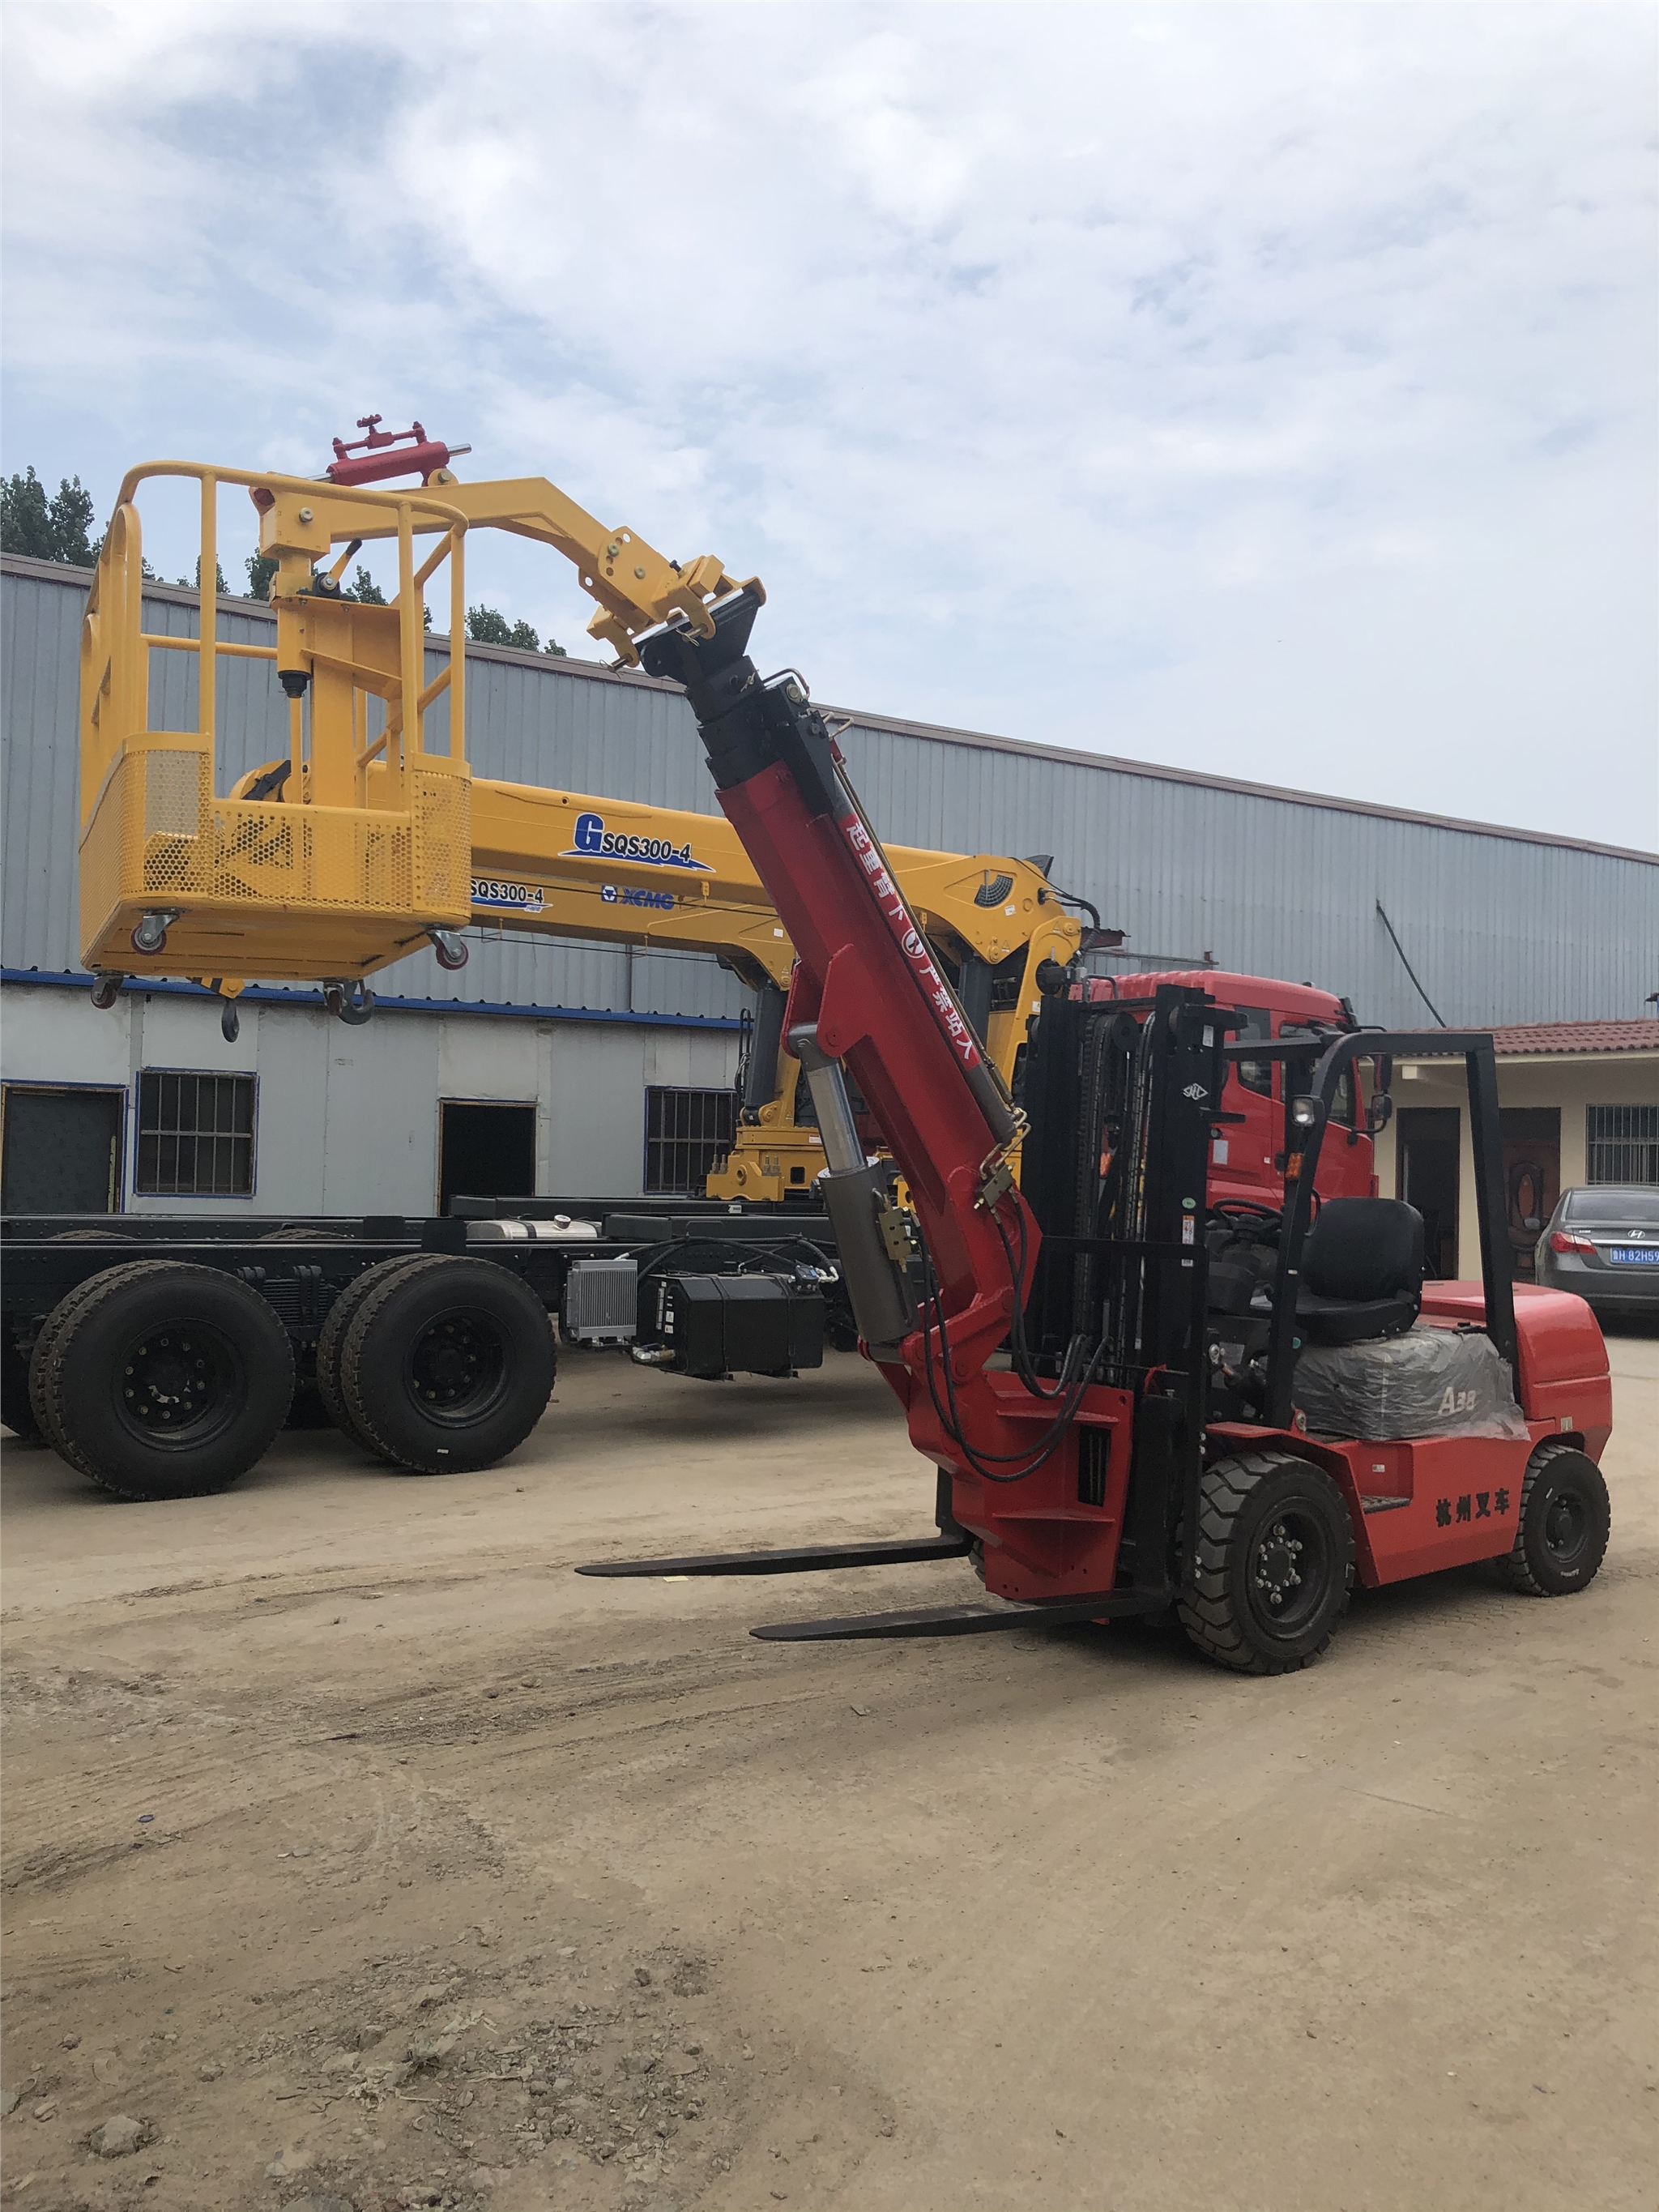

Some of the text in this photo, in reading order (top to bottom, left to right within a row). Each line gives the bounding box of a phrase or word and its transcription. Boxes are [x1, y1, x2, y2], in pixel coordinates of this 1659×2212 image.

[621, 888, 675, 911] XCMG
[846, 822, 973, 1060] 起重臂下 严禁站人
[1435, 1487, 1510, 1528] 杭州叉车
